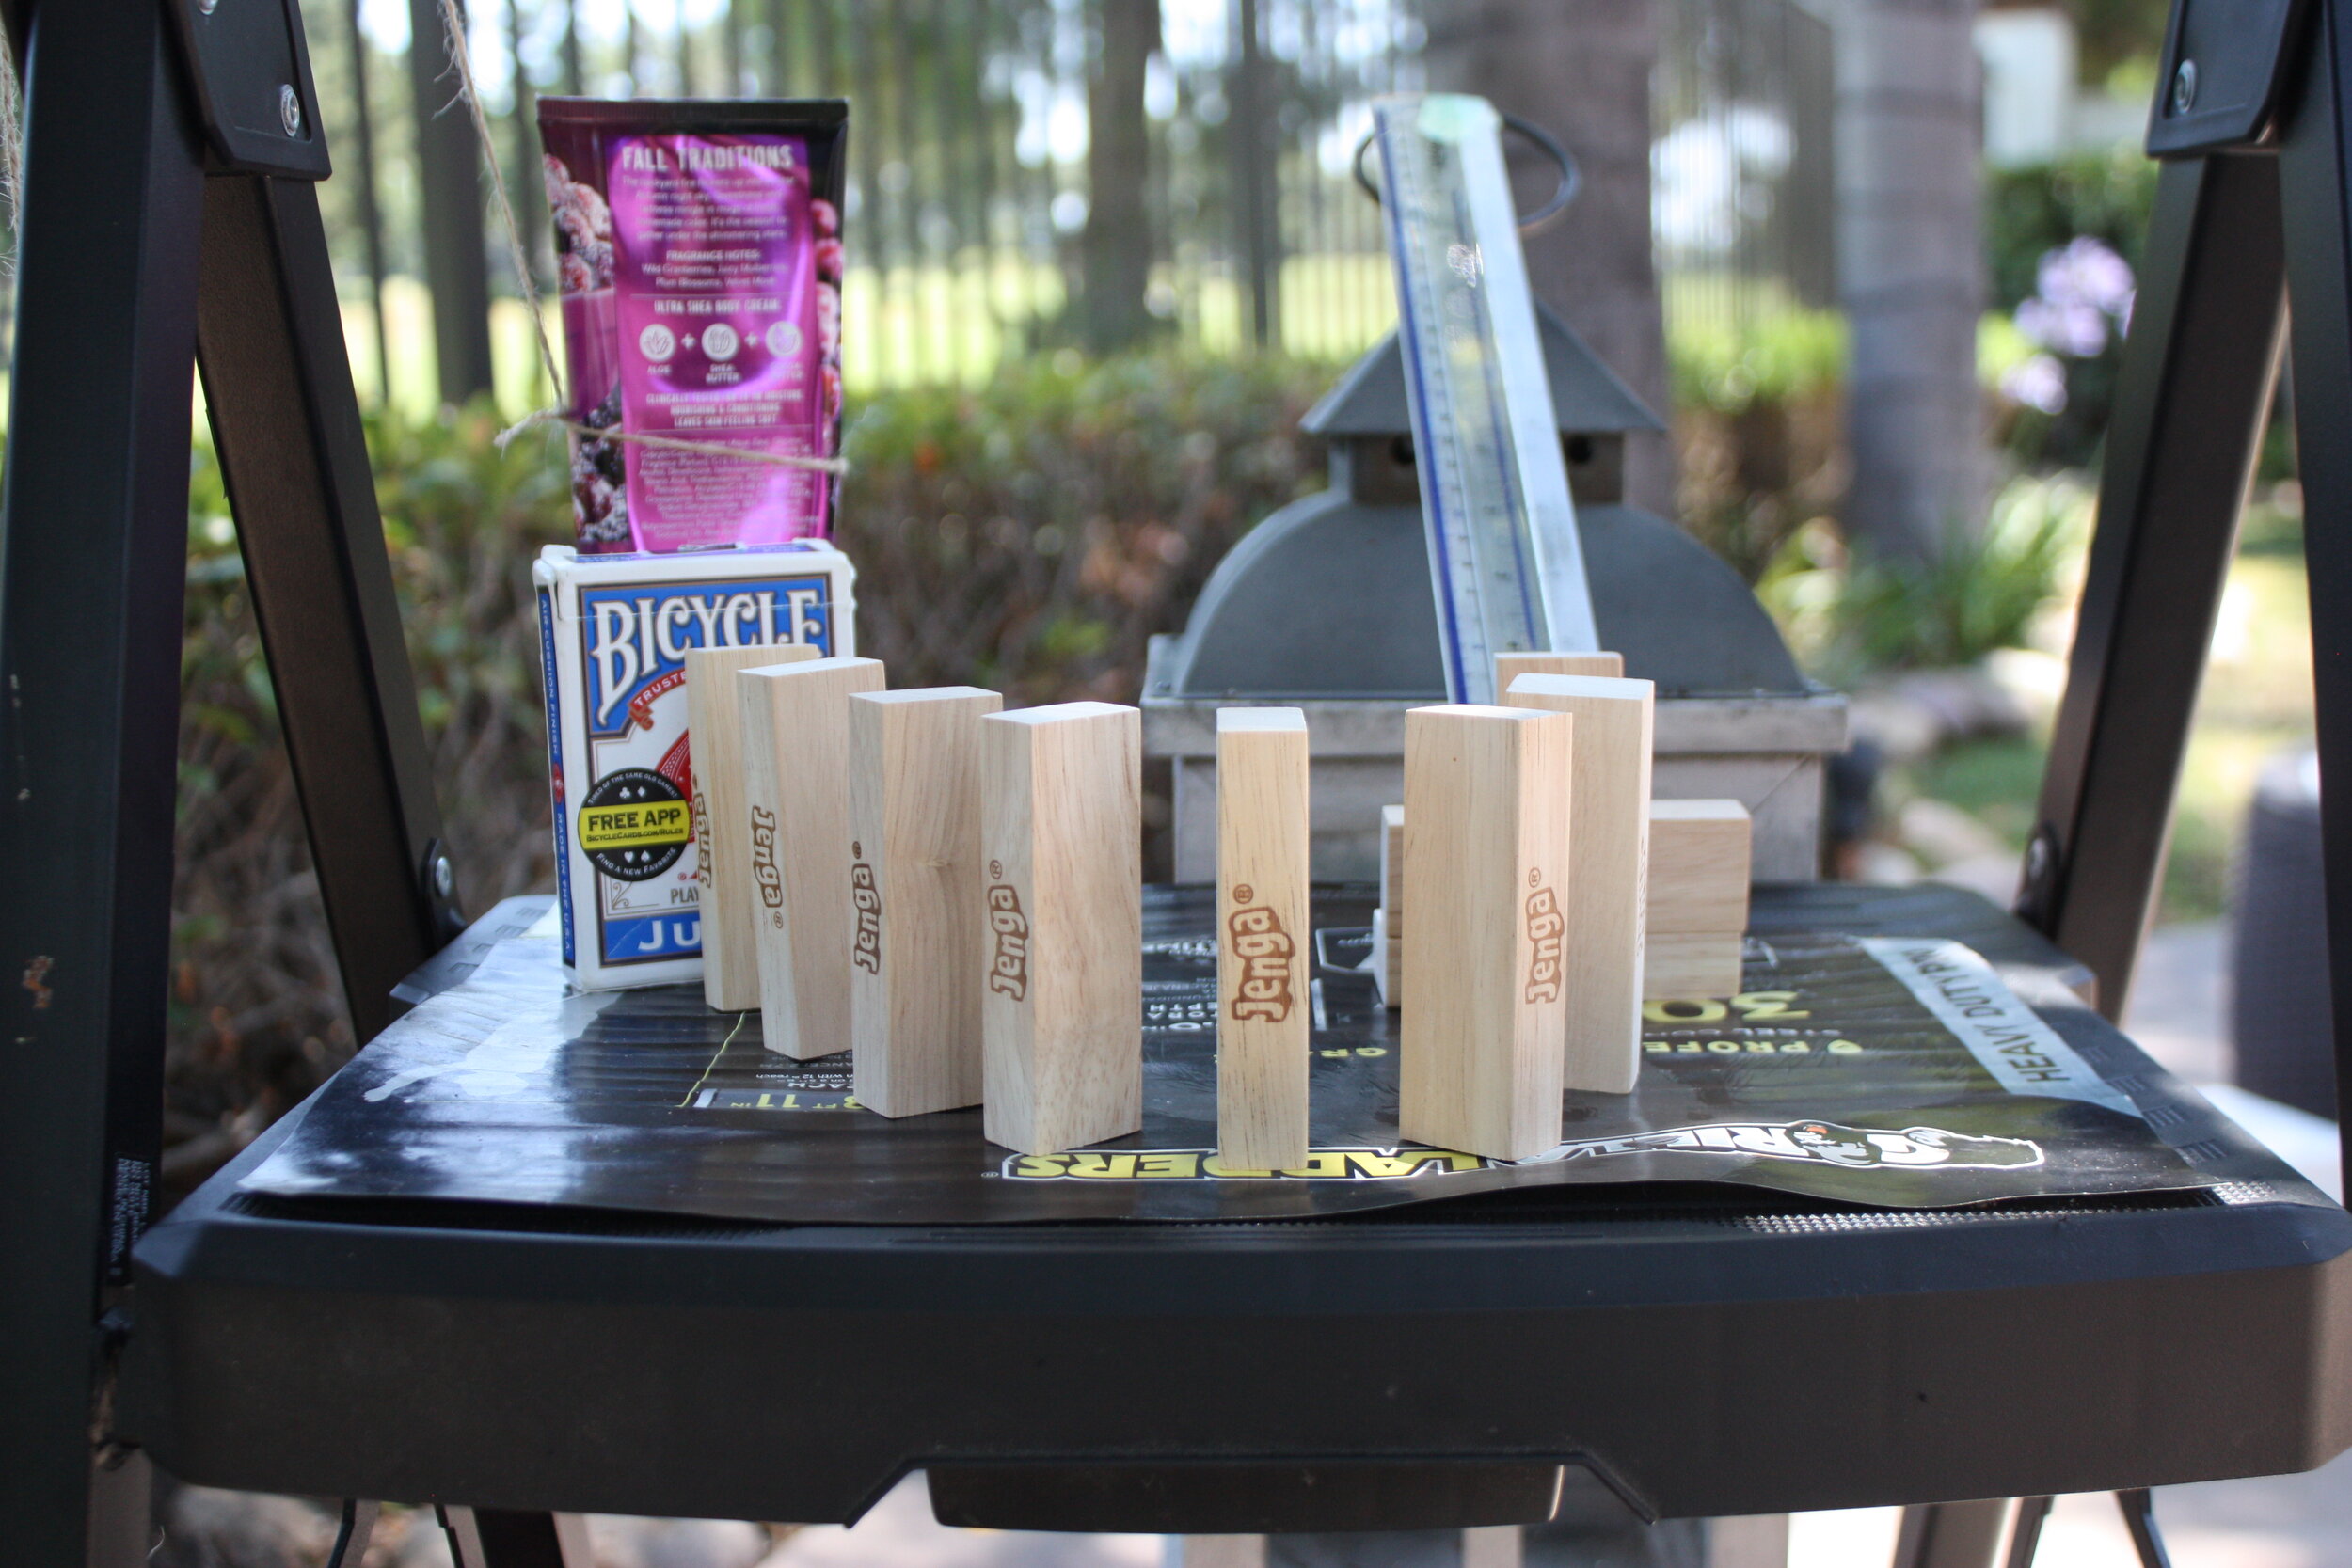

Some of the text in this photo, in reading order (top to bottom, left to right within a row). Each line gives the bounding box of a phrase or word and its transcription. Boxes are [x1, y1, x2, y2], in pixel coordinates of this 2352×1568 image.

[622, 144, 794, 172] FALL TRADITIONS
[654, 299, 685, 314] ULTRA
[687, 299, 713, 314] SHEA
[715, 299, 739, 313] BODY
[647, 364, 671, 375] ALOE
[706, 372, 741, 385] BUTTER
[590, 588, 825, 727] BICYCLE
[634, 671, 687, 707] TRUSTE
[588, 786, 605, 805] TIRED
[602, 780, 611, 789] OF
[611, 773, 624, 784] THE
[644, 772, 657, 782] OLD
[587, 811, 640, 832] FREE
[644, 807, 681, 828] APP
[557, 812, 565, 855] MADE
[561, 858, 566, 874] IN
[751, 805, 783, 908] Jenga
[596, 851, 614, 870] FIND
[623, 867, 642, 876] NEW
[643, 847, 676, 873] FAVORITE
[670, 886, 700, 904] PLAY
[639, 920, 700, 950] JU
[851, 863, 882, 975] Jenga
[988, 884, 1029, 1002] Jenga
[1525, 887, 1565, 1004] Jenga
[1228, 905, 1295, 1023] Jenga
[1150, 1002, 1216, 1012] EPTH
[1934, 974, 2007, 1018] DUTY
[1642, 1040, 1810, 1053] PROFE
[1974, 1024, 2072, 1082] HEAVY
